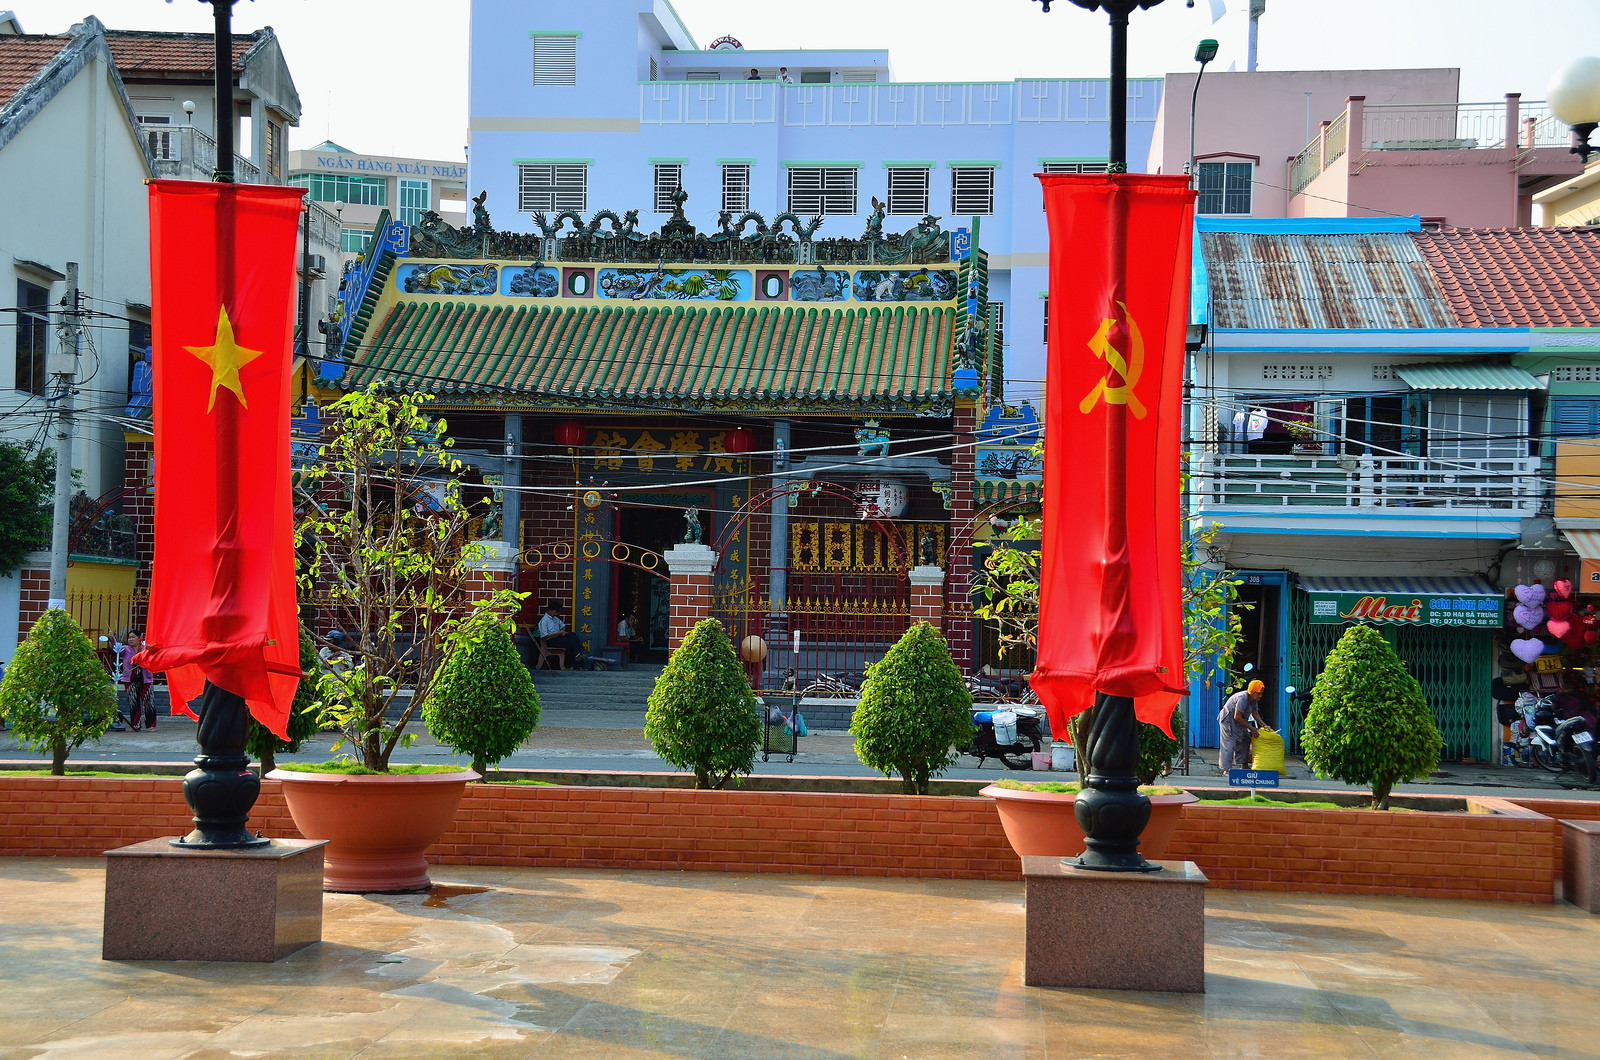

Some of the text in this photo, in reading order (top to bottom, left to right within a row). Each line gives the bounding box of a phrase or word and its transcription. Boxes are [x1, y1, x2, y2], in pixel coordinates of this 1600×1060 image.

[317, 156, 467, 179] NGÂN HÀNG XUẤT NHẬP
[1340, 596, 1422, 622] Mai
[1429, 596, 1499, 611] CƠM BÌNH DÂN
